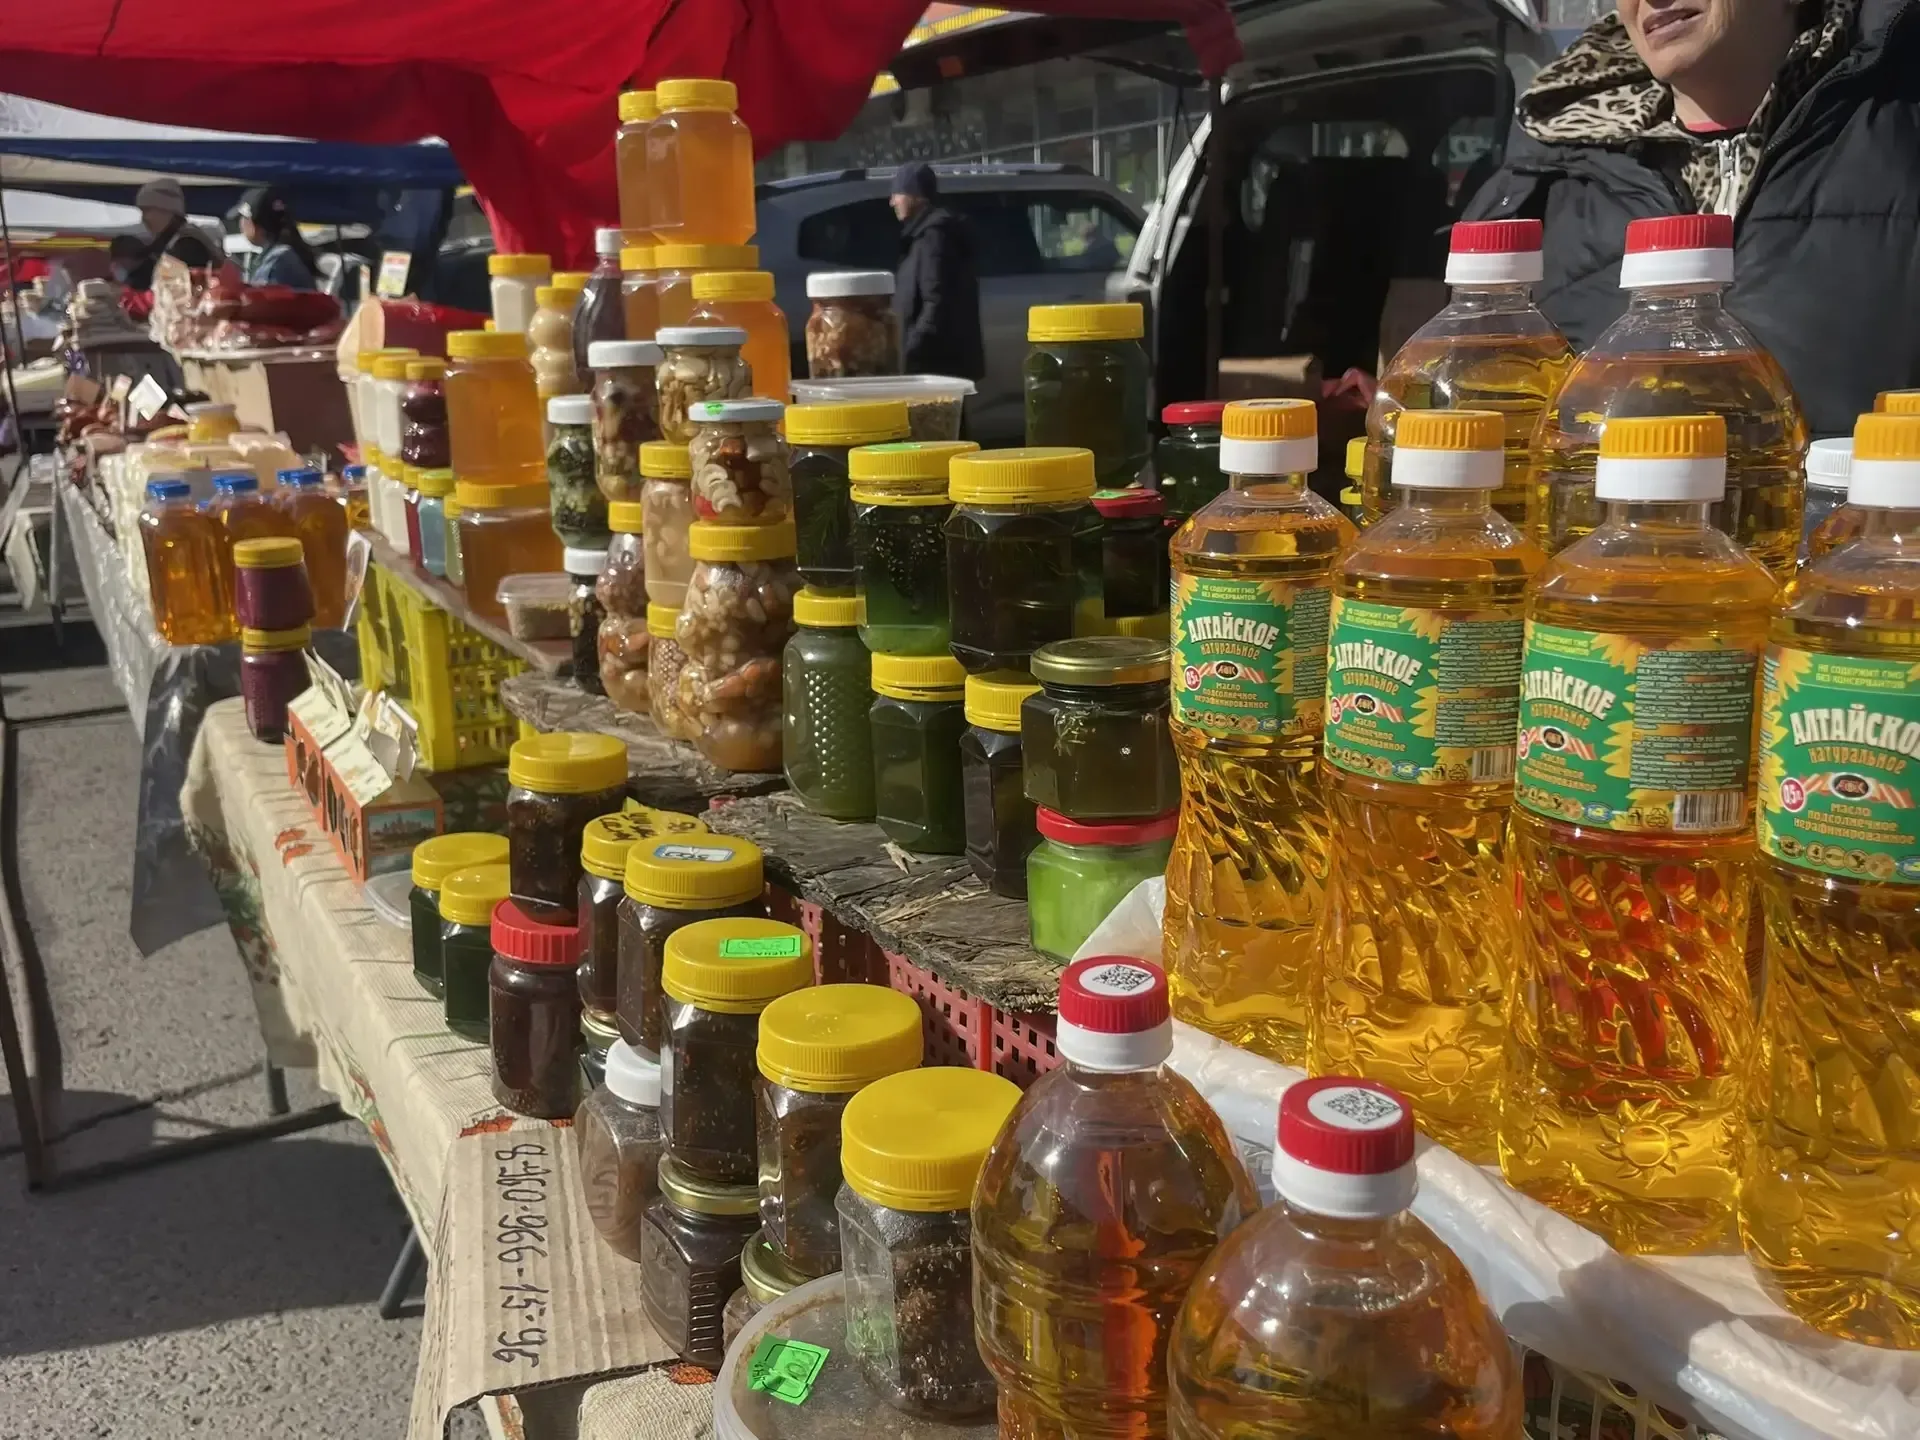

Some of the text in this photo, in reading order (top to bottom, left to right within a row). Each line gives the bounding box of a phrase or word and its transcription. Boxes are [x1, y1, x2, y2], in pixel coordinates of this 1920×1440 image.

[1187, 611, 1280, 651] АЛТАЙСКОЕ
[1201, 642, 1260, 660] натуральное
[1334, 639, 1423, 687] АЛТАЙСКОЕ
[1216, 682, 1241, 691] масло
[1524, 666, 1617, 721] АЛТАЙСКОЕ
[1789, 703, 1920, 761] АЛТАЙСКО
[1808, 746, 1907, 775] натуральное
[1830, 803, 1872, 817] масло
